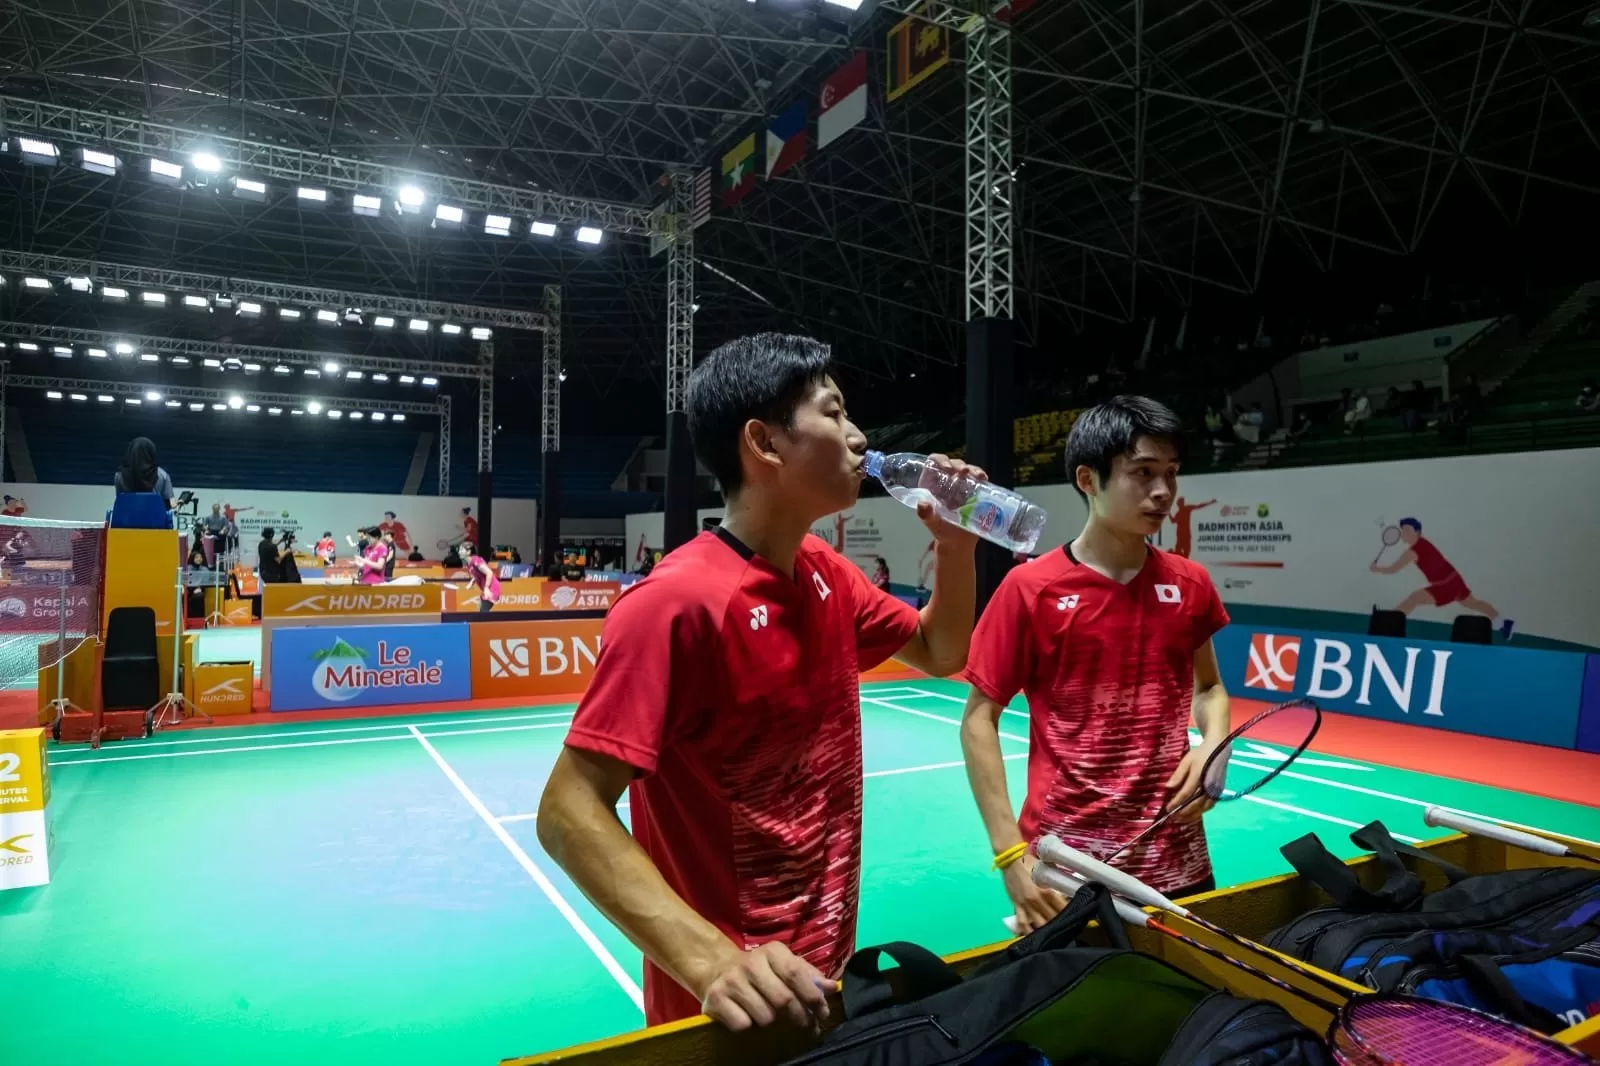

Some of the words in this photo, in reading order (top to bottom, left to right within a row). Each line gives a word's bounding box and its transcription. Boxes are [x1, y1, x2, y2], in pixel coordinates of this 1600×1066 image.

[1198, 521, 1257, 532] BADMINTON
[1259, 521, 1284, 531] ASIA
[1198, 534, 1225, 542] JUNIOR
[1226, 534, 1292, 542] CHAMPIONSHIPS
[328, 594, 426, 610] HUNDRED
[576, 595, 609, 607] ASIA
[378, 640, 411, 667] Le
[537, 635, 602, 676] BN
[322, 662, 441, 690] Minerale
[1305, 638, 1453, 717] BNI
[200, 693, 245, 703] HUNDRED
[0, 752, 21, 782] 2
[0, 786, 28, 796] UTES
